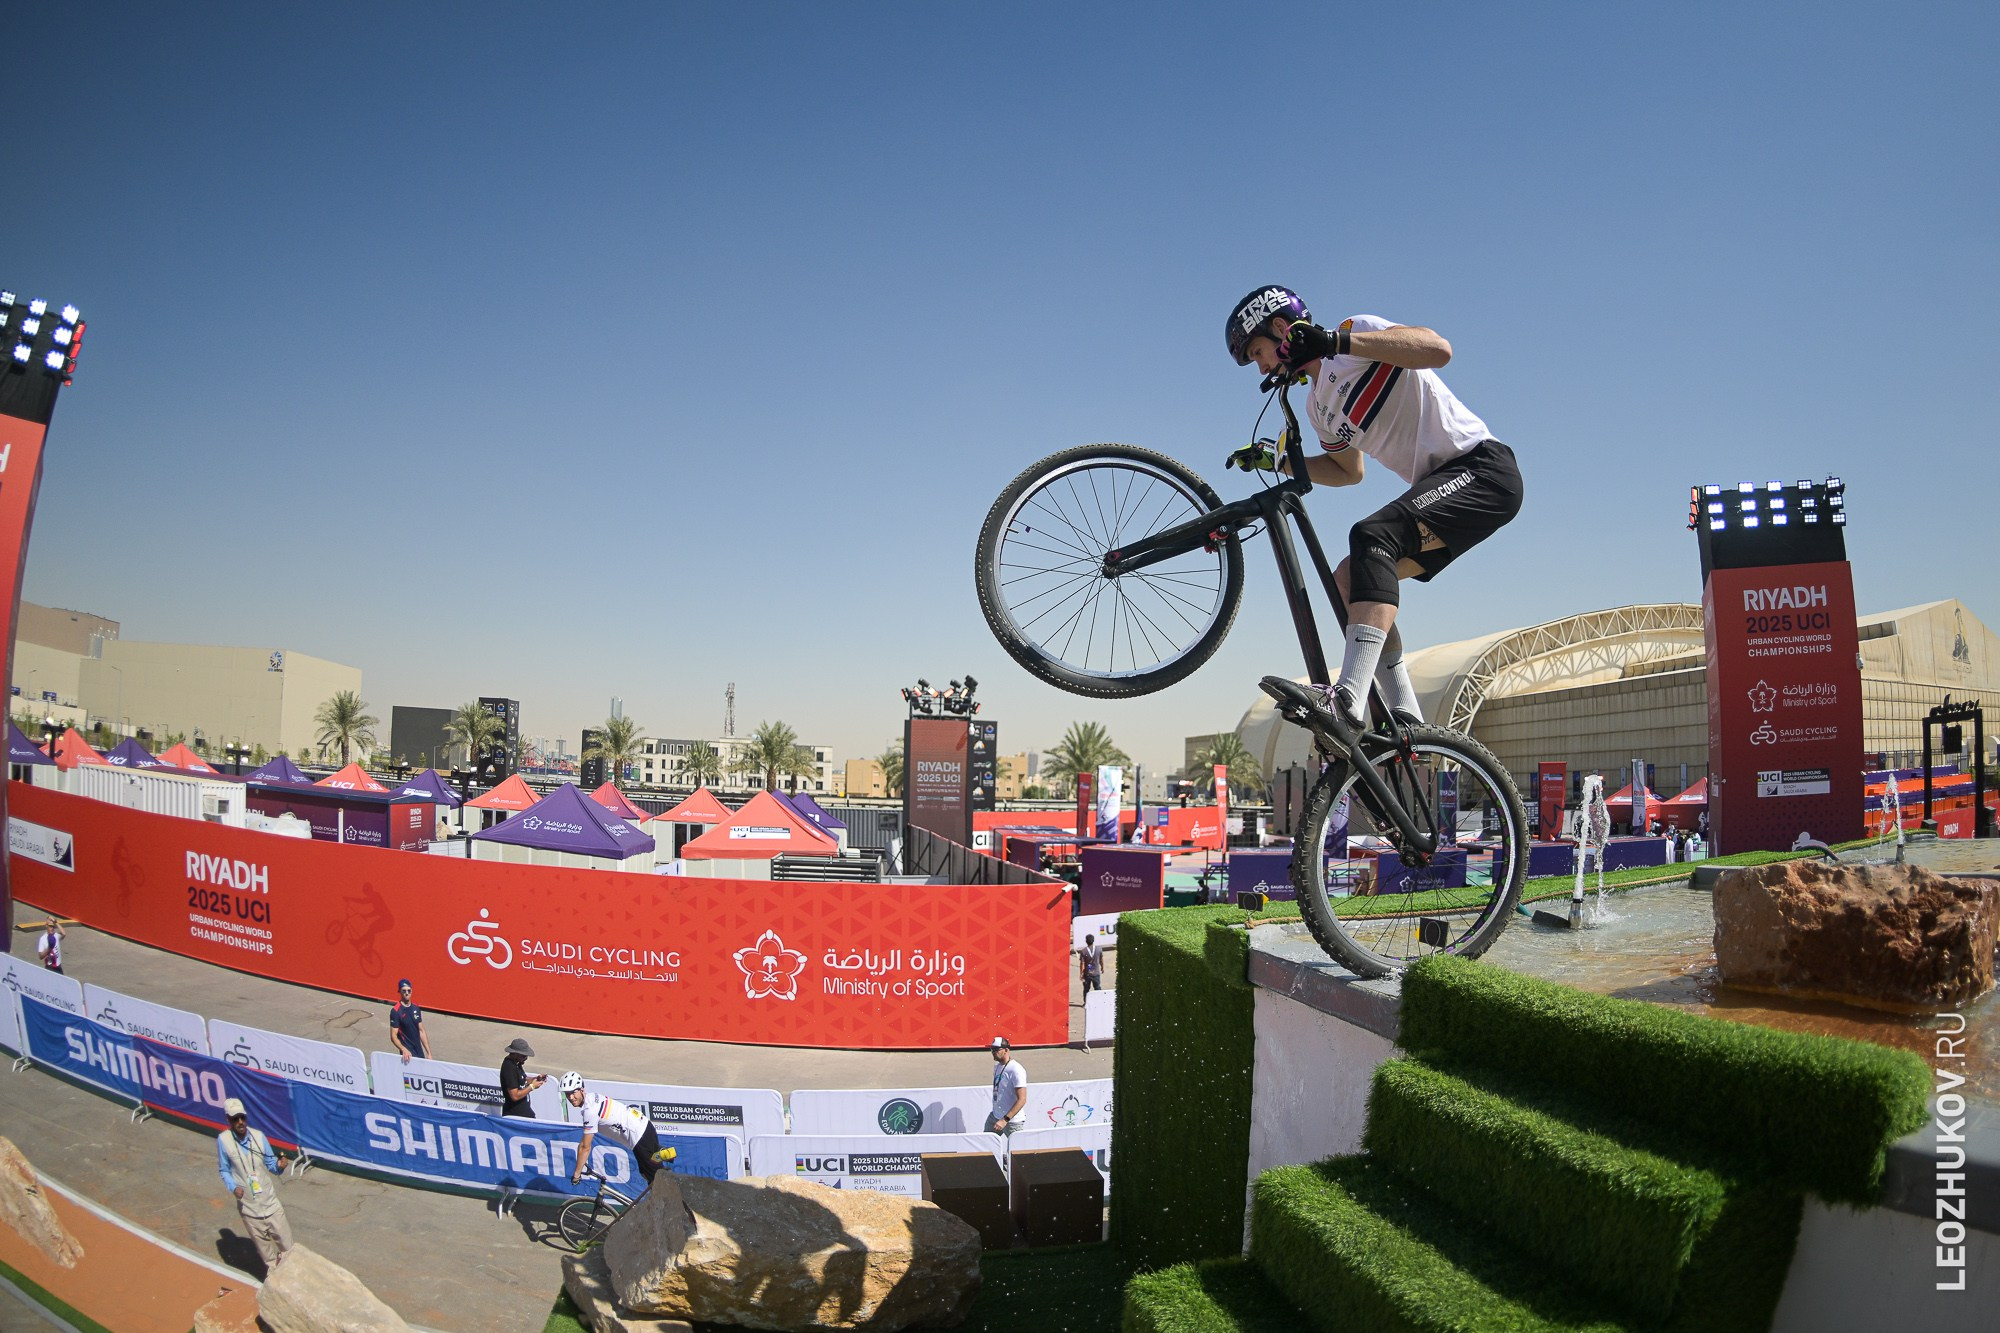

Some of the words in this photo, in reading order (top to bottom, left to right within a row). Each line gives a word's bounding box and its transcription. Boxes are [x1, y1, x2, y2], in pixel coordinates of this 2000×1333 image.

[1237, 287, 1285, 320] TRIAL
[1241, 294, 1291, 334] BIKES
[1336, 422, 1356, 443] BR
[1412, 489, 1441, 510] MIND
[1437, 470, 1476, 497] CONTROL
[1743, 585, 1828, 611] RIYADH
[1746, 614, 1793, 633] 2025
[1796, 612, 1831, 630] UCI
[1747, 637, 1773, 646] URBAN
[1773, 635, 1806, 644] CYCLING
[1806, 633, 1832, 642] WORLD
[1748, 644, 1832, 658] CHAMPIONSHIPS
[1782, 684, 1813, 697] الرياضة
[1815, 683, 1837, 696] وزارة
[1782, 697, 1808, 708] Ministry
[1809, 697, 1818, 706] of
[1817, 696, 1837, 707] Sport
[1779, 728, 1804, 737] SAUDI
[1804, 726, 1838, 736] CYCLING
[107, 755, 128, 765] UCI
[917, 761, 961, 772] RIYADH
[331, 780, 356, 789] UCI
[917, 773, 941, 782] 2025
[942, 774, 961, 783] UCI
[1761, 773, 1780, 783] UCI
[975, 834, 987, 846] CI
[186, 850, 269, 894] RIYADH
[187, 886, 231, 916] 2025
[235, 896, 271, 924] UCI
[189, 913, 213, 927] URBAN
[213, 919, 245, 934] CYCLING
[244, 925, 273, 940] WORLD
[190, 926, 273, 955] CHAMPIONSHIPS
[520, 939, 583, 960] SAUDI
[589, 946, 682, 968] CYCLING
[822, 948, 902, 976] الرياضة
[909, 949, 965, 976] وزارة
[823, 976, 889, 999] Ministry
[892, 978, 912, 996] of
[915, 978, 965, 999] Sport
[24, 985, 45, 1000] SAUDI
[45, 994, 76, 1013] CYCLING
[127, 1022, 155, 1038] SAUDI
[157, 1031, 198, 1051] CYCLING
[64, 1026, 227, 1109] SHIMANO
[264, 1059, 300, 1075] SAUDI
[302, 1067, 354, 1085] CYCLING
[410, 1077, 440, 1094] UCI
[443, 1082, 458, 1090] 2025
[458, 1085, 480, 1093] URBAN
[480, 1087, 504, 1097] CYCLIN
[445, 1089, 468, 1098] WORLD
[652, 1112, 679, 1120] WORLD
[679, 1113, 740, 1123] CHAMPIONSHIPS
[669, 1106, 694, 1114] URBAN
[694, 1107, 726, 1115] CYCLING
[364, 1112, 631, 1185] SHIMANO
[805, 1157, 845, 1172] UCI
[852, 1164, 884, 1172] WORLD
[872, 1156, 901, 1164] URBAN
[901, 1156, 922, 1164] CYCL
